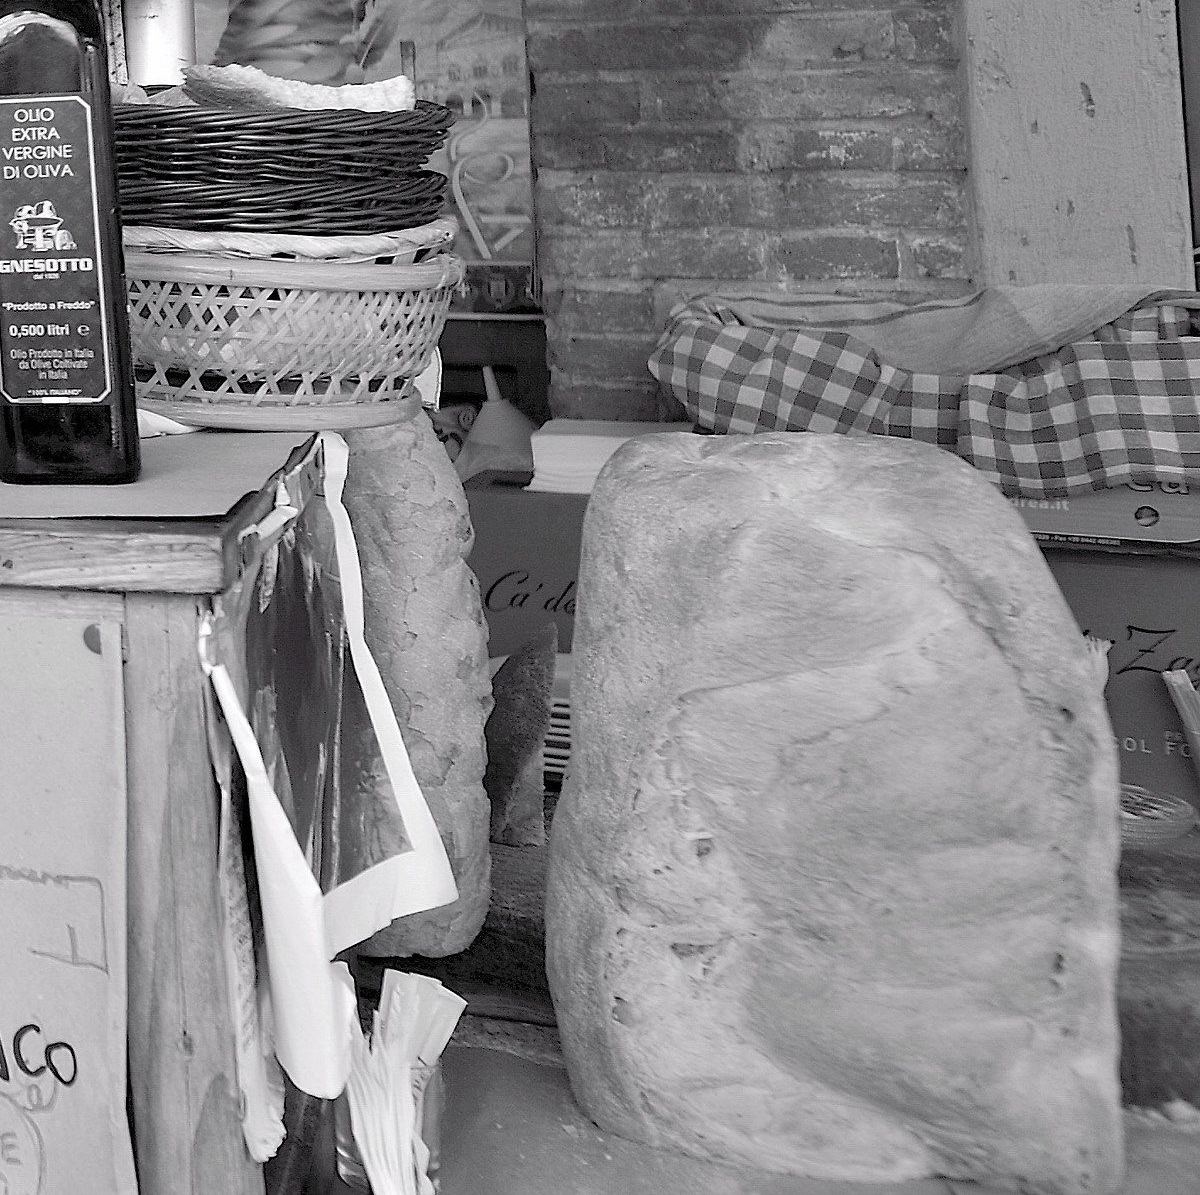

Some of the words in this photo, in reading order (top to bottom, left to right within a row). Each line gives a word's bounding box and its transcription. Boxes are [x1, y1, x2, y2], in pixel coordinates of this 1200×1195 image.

[14, 108, 55, 123] OLIO
[11, 127, 61, 142] EXTRA
[2, 144, 73, 161] VERGINE
[3, 166, 20, 180] DI
[23, 163, 75, 179] OLIVA
[8, 324, 46, 339] 0,500
[47, 323, 70, 336] litri
